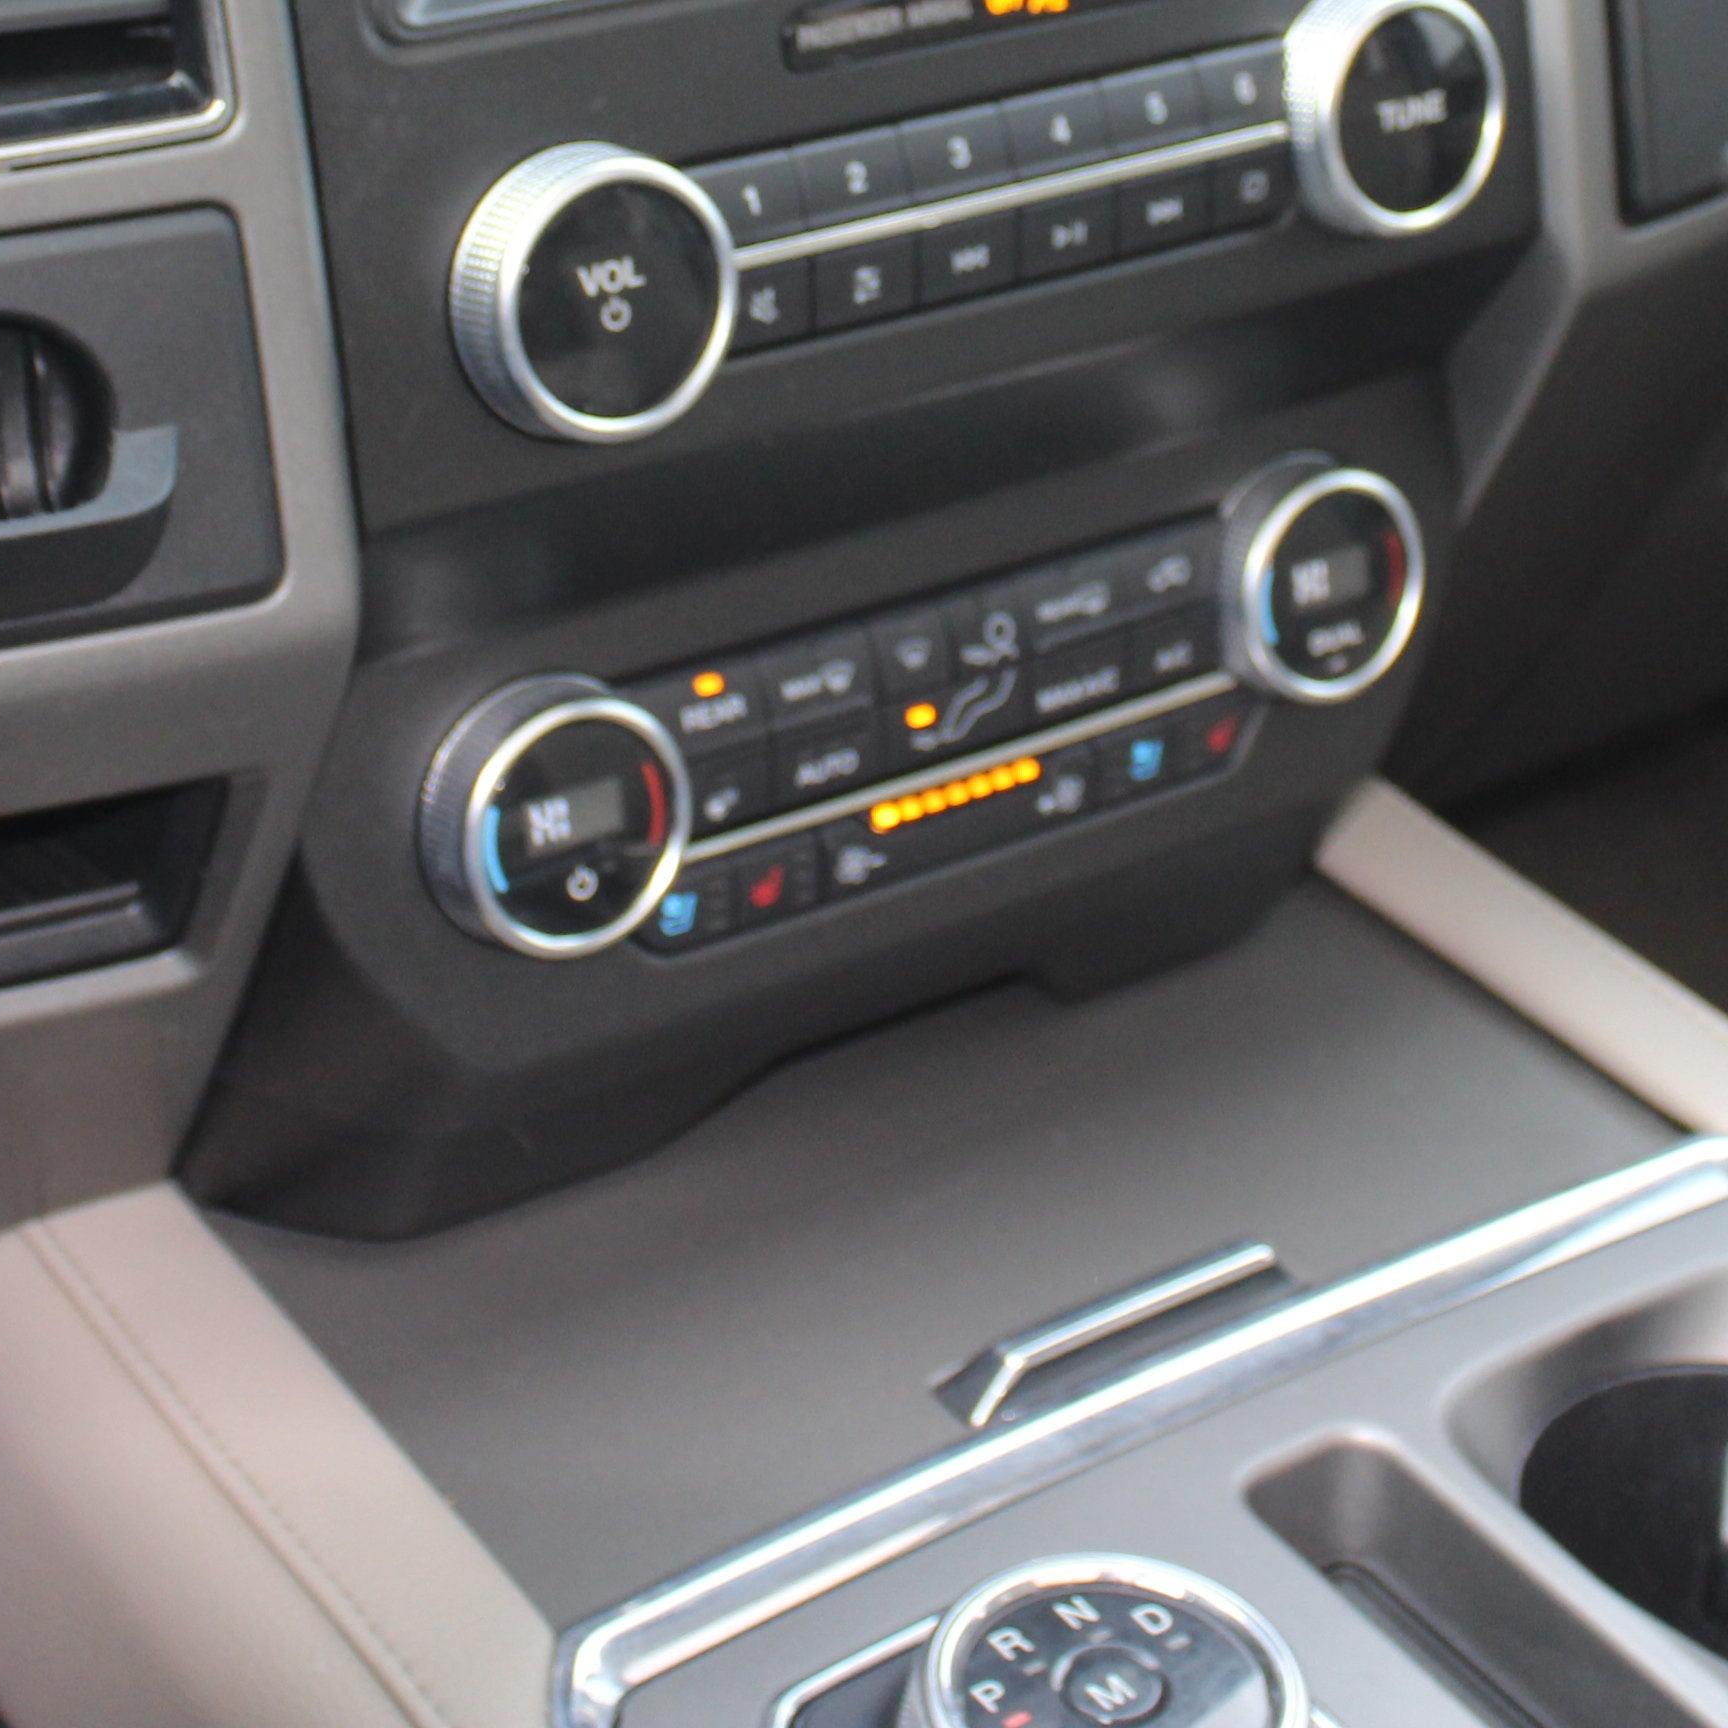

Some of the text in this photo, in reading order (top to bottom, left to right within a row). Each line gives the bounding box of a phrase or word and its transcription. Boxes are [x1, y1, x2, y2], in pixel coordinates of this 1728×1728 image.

[1376, 89, 1447, 132] TUNE
[1049, 115, 1071, 145] 4
[948, 136, 971, 167] 3
[846, 162, 868, 194] 2
[743, 184, 763, 217] 1
[577, 256, 645, 296] VOL
[1052, 1595, 1100, 1630] N
[1130, 1603, 1173, 1637] D
[986, 1626, 1034, 1661] R
[969, 1679, 1005, 1713] P
[1084, 1673, 1138, 1712] M
